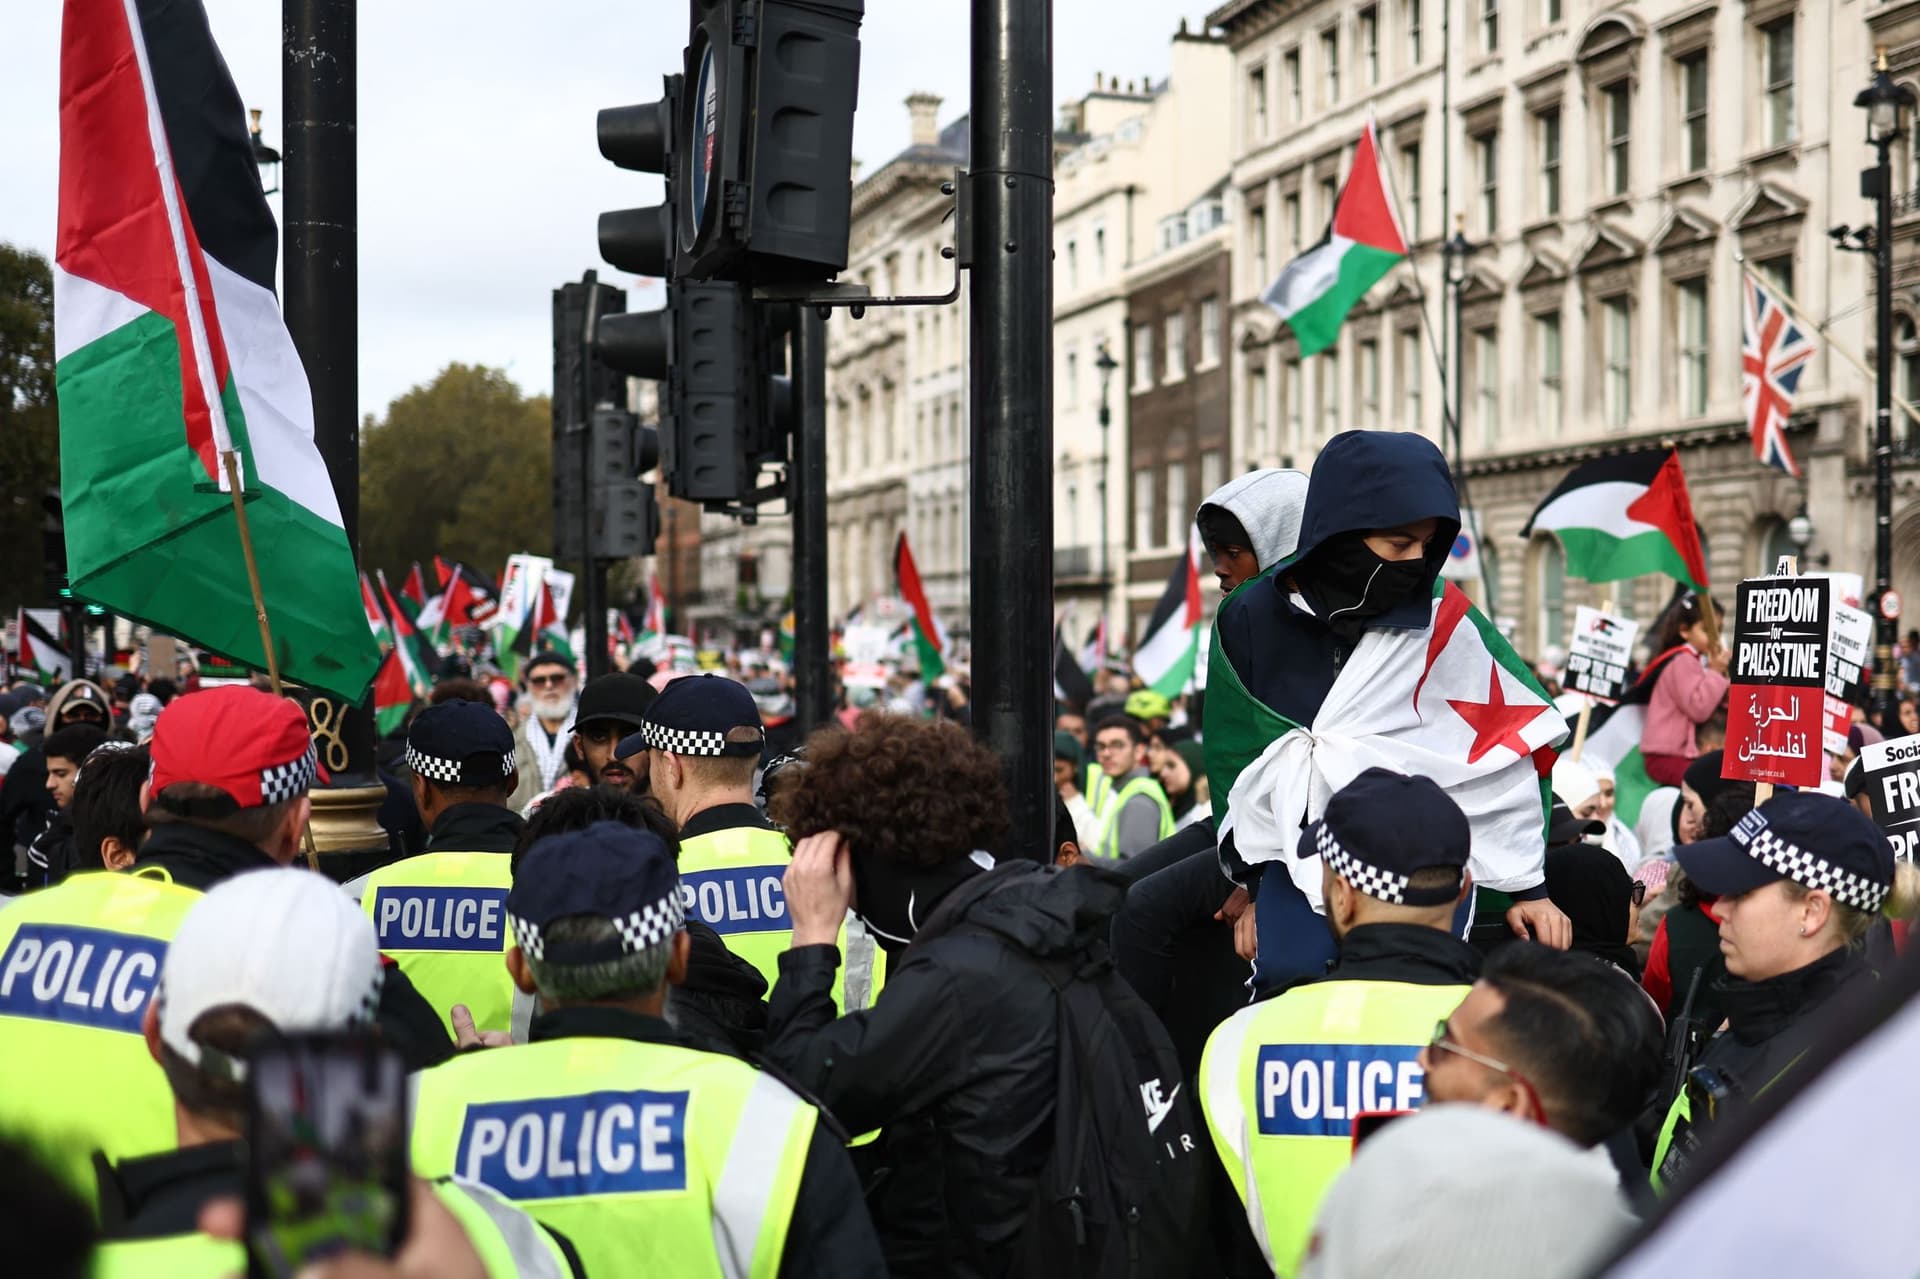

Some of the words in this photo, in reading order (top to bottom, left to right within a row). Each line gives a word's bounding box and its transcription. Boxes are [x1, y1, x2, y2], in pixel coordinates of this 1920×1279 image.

[1746, 588, 1819, 623] FREEDOM
[1770, 623, 1783, 640] for
[1738, 642, 1821, 678] PALESTINE
[1748, 693, 1799, 728] الحرية
[1738, 728, 1807, 762] لفلسطين
[1885, 741, 1920, 762] Soci
[1882, 769, 1920, 813] FR
[380, 897, 500, 938] POLICE
[681, 876, 785, 923] POLIC
[0, 938, 158, 1013] POLIC
[1263, 1059, 1424, 1120] POLICE
[466, 1103, 675, 1182] POLICE
